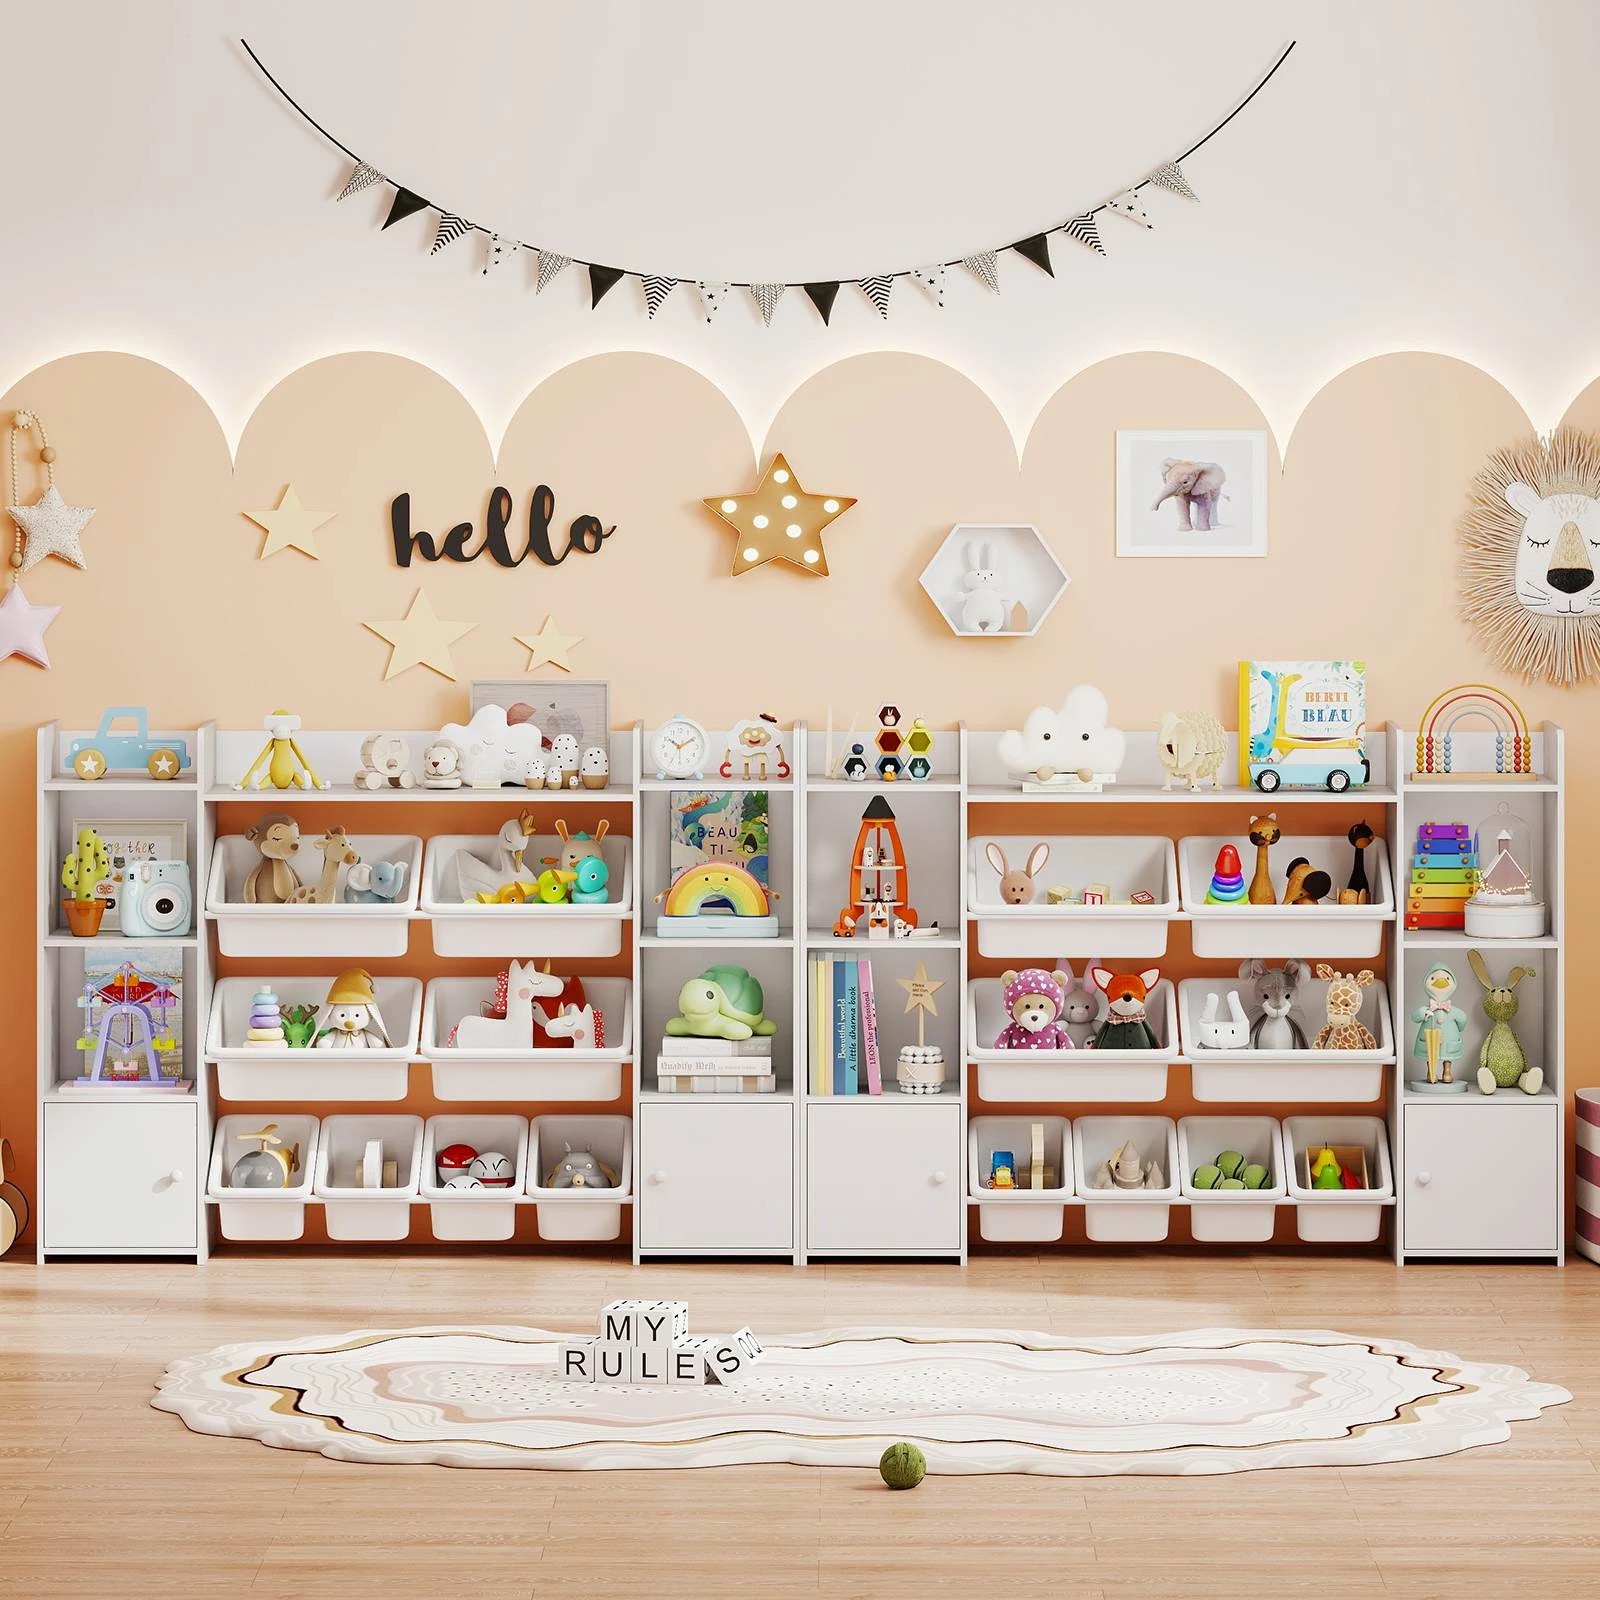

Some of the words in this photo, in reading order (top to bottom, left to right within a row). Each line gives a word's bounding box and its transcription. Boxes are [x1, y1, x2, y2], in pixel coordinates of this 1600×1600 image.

[392, 485, 617, 567] hello
[837, 998, 846, 1020] world
[848, 986, 857, 1005] book
[849, 1008, 857, 1040] dharma
[862, 991, 874, 1031] professional
[837, 1022, 846, 1059] Beautiful
[849, 1043, 857, 1062] little
[868, 1044, 877, 1065] LEON
[606, 1315, 666, 1342] MY
[565, 1347, 741, 1379] RULES
